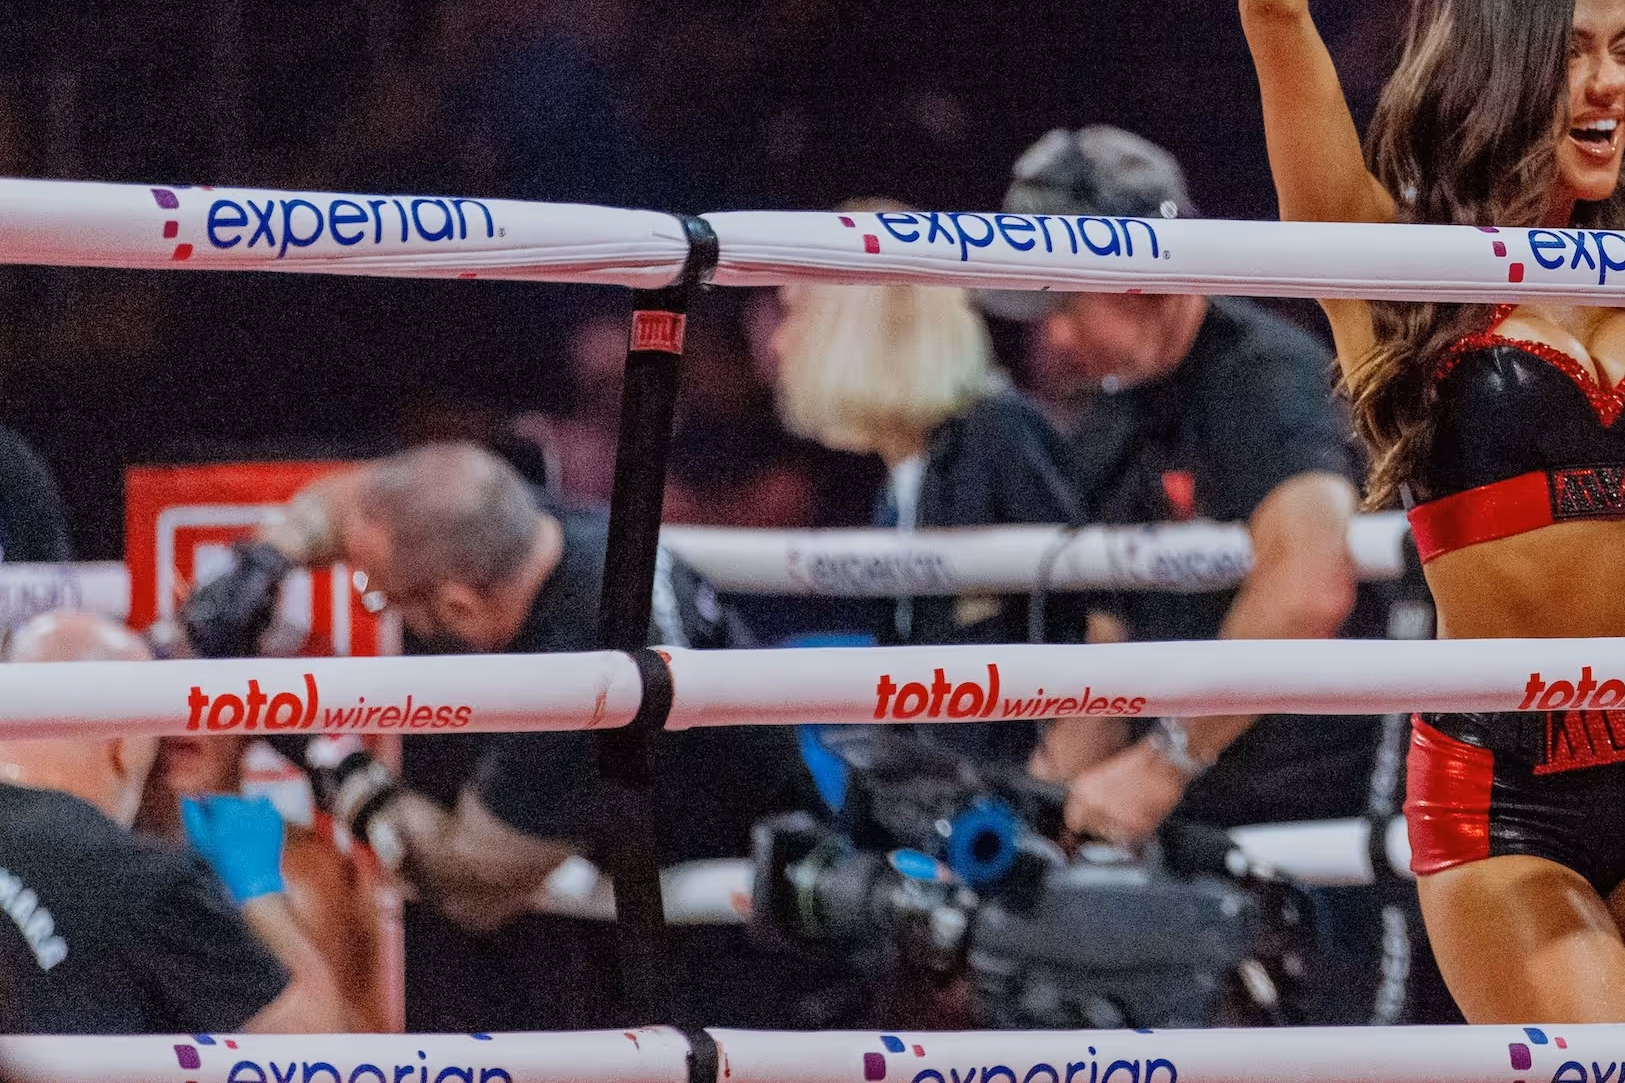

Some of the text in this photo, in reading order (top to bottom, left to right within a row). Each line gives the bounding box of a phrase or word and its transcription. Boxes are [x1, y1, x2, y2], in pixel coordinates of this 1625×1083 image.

[206, 196, 497, 259] experian
[876, 212, 1160, 261] experian
[187, 673, 472, 730] total wireless
[873, 664, 1147, 718] total wireless
